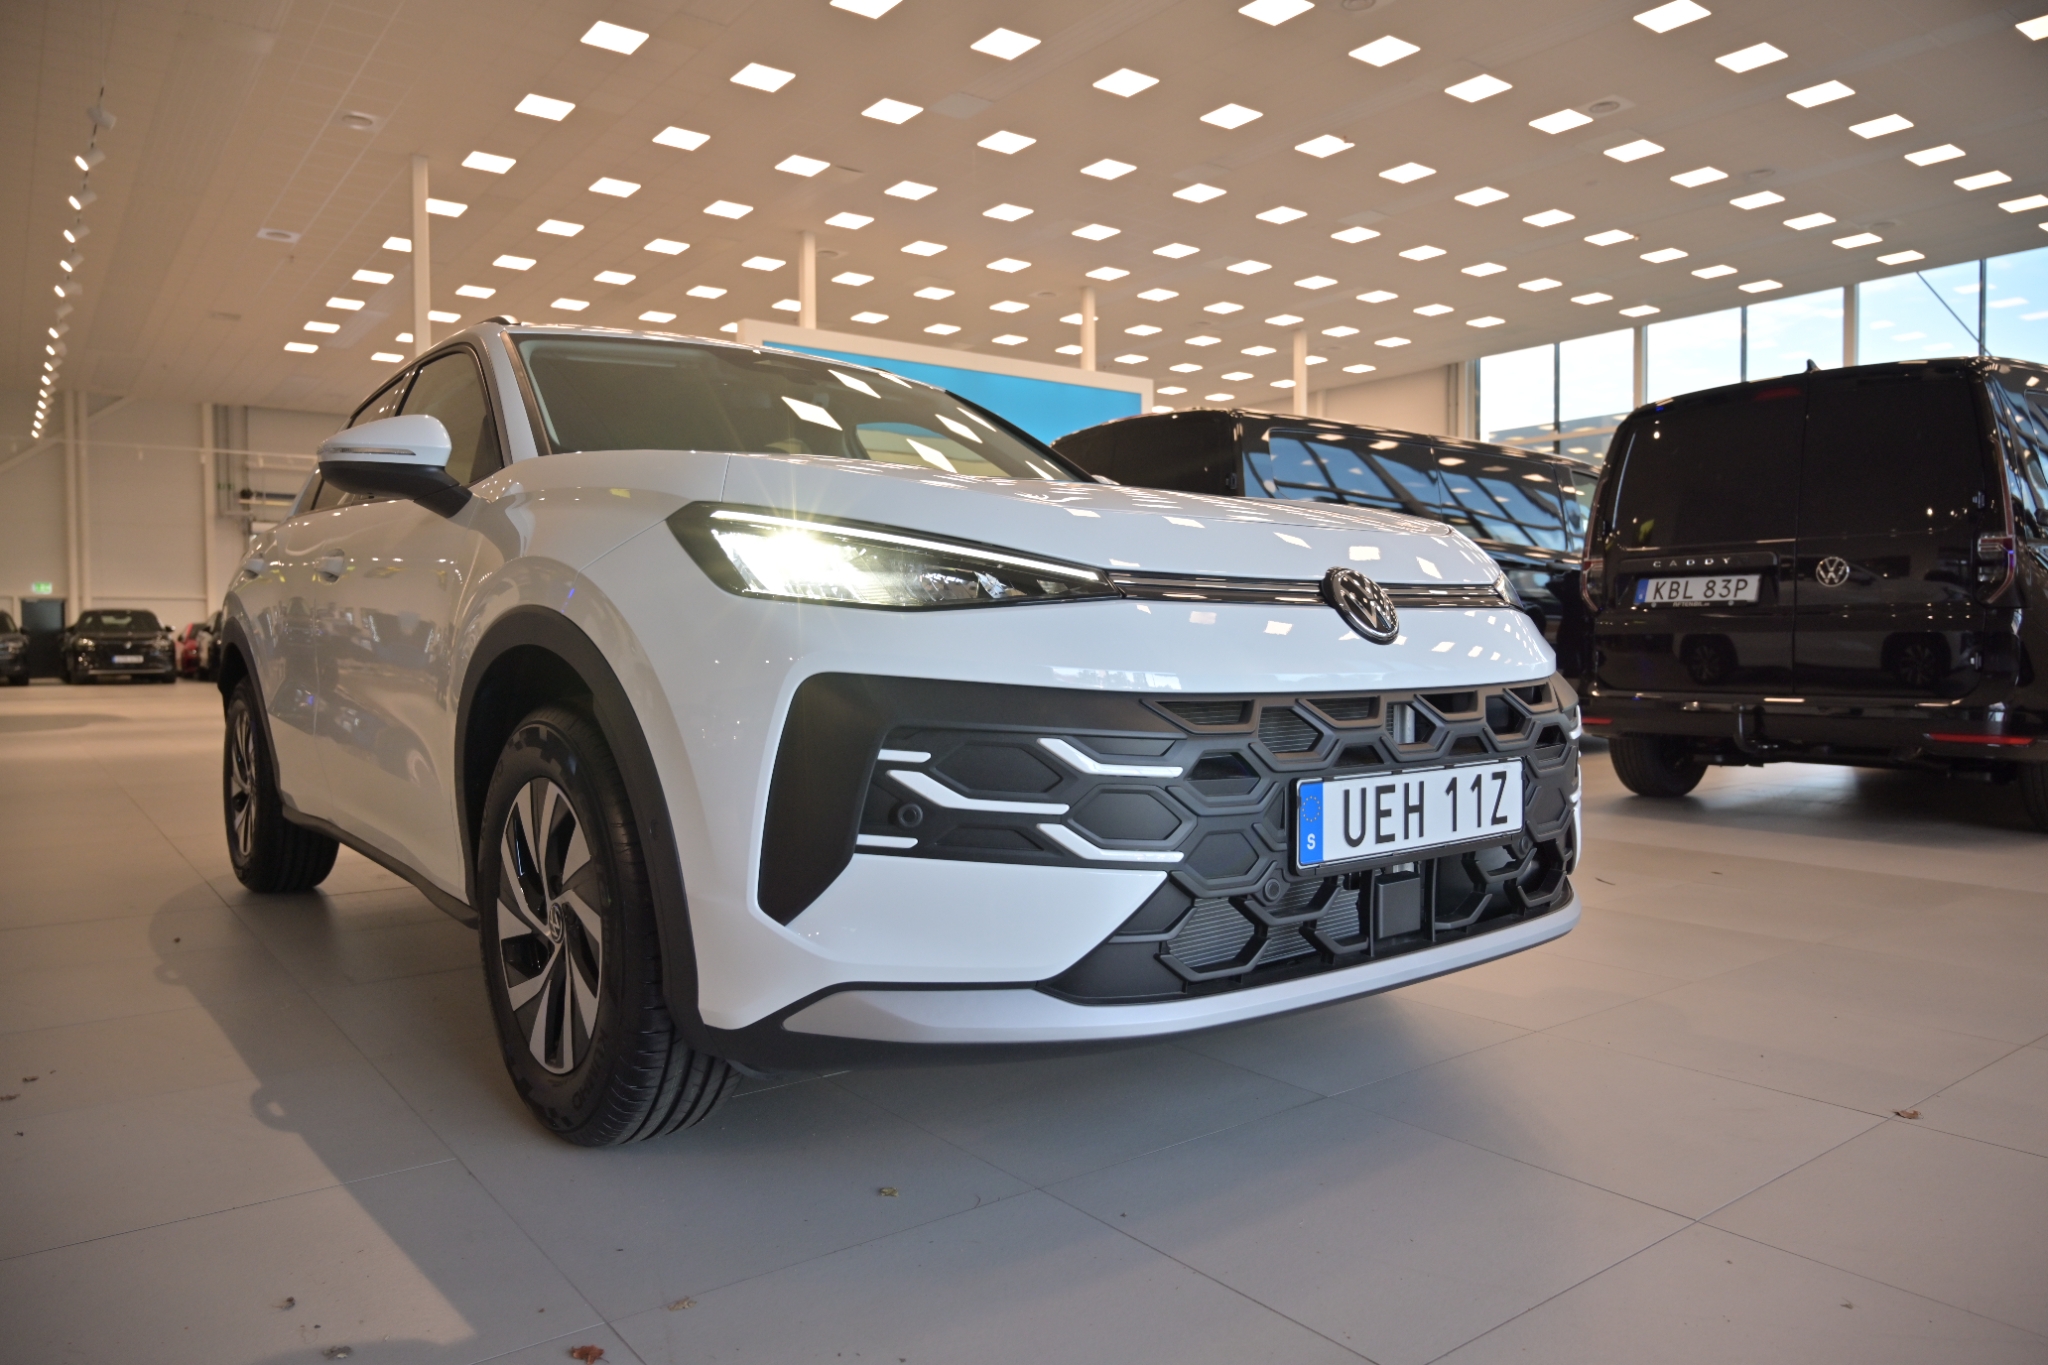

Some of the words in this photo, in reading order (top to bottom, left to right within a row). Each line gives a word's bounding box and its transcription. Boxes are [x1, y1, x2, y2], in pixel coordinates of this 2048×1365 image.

[1652, 556, 1731, 568] CADDY
[1653, 580, 1694, 600] KBL
[1703, 579, 1748, 599] 83P
[1343, 780, 1425, 848] UEH
[1444, 770, 1508, 832] 11Z
[1306, 833, 1316, 850] S
